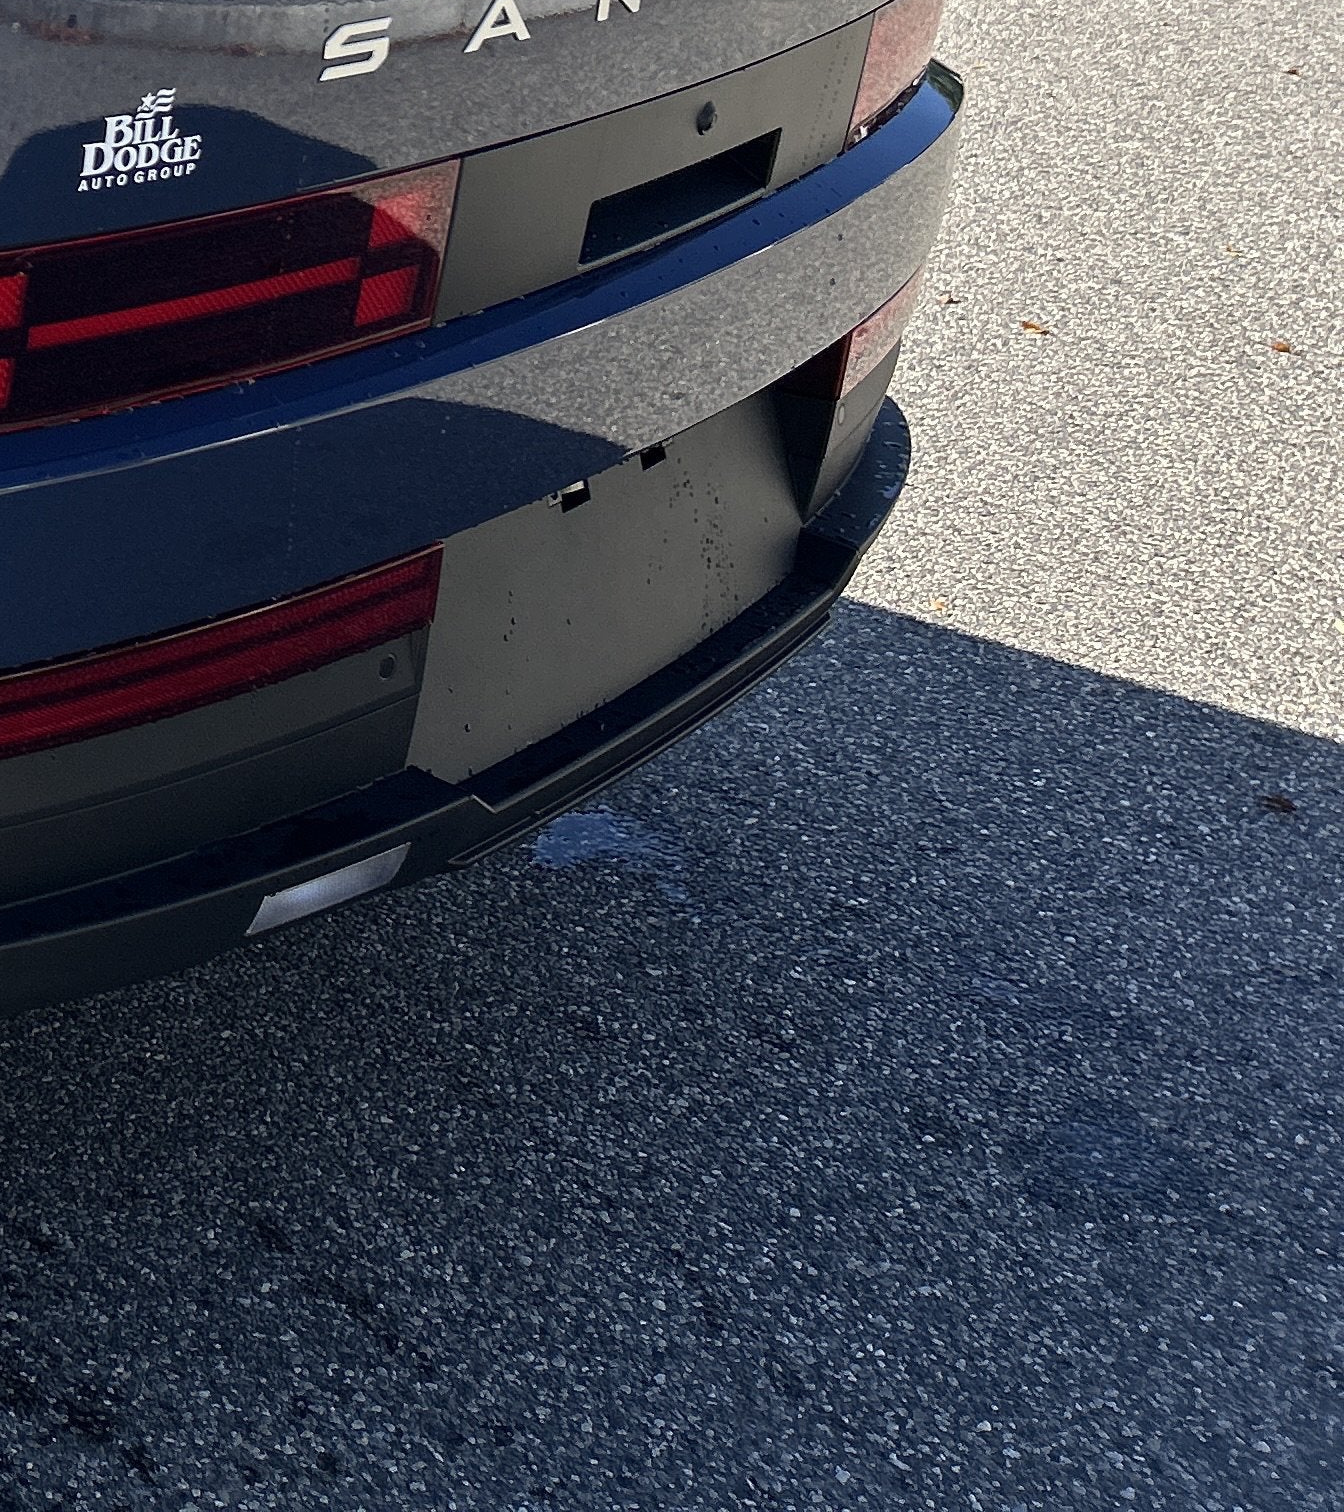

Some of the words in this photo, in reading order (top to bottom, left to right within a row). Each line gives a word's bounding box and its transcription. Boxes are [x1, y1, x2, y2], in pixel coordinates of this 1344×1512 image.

[104, 114, 180, 148] BILL
[80, 135, 202, 176] DODGE
[78, 173, 129, 192] AUTO
[134, 162, 197, 183] GROUP
